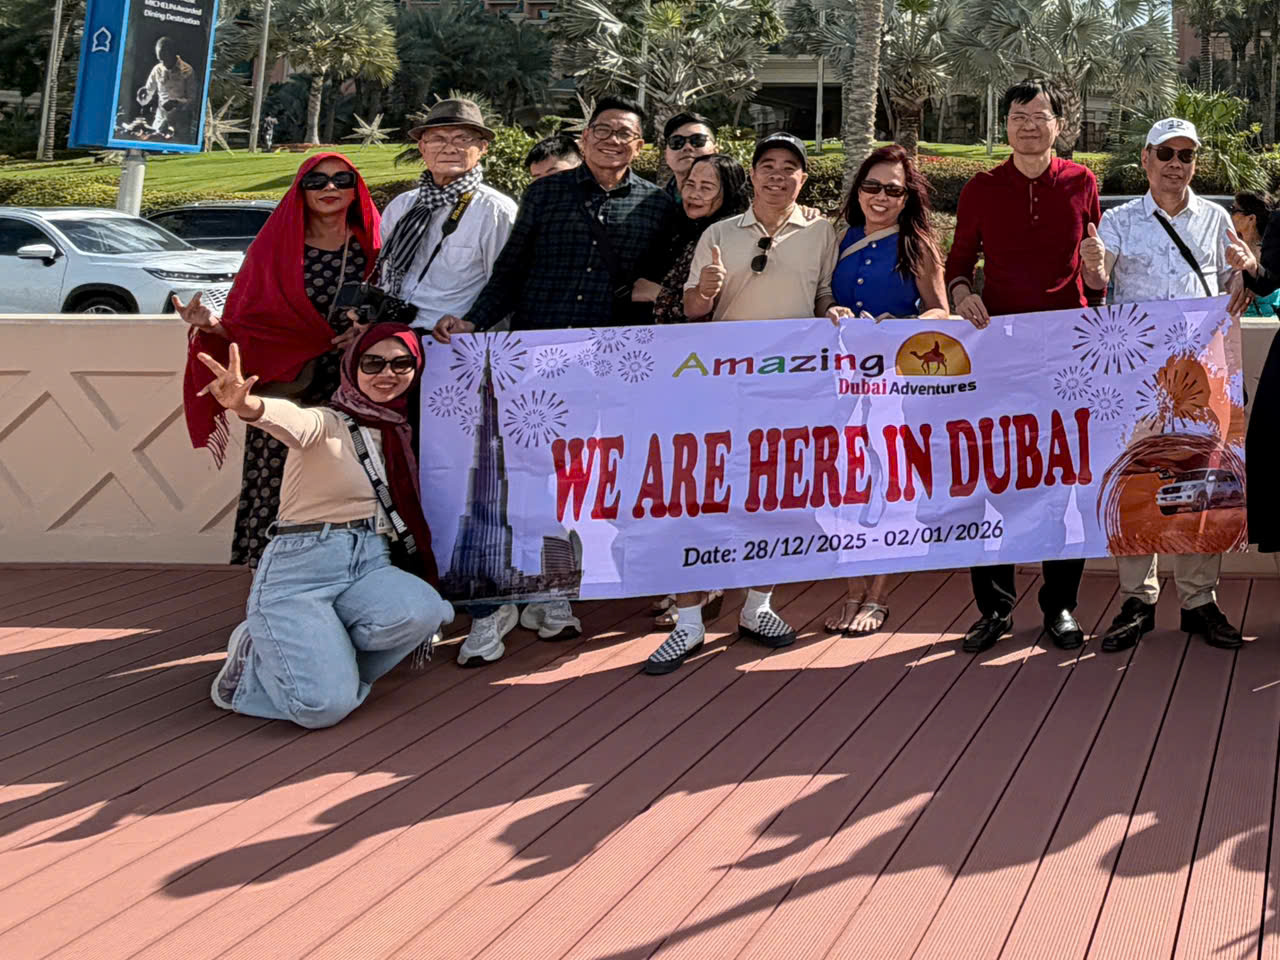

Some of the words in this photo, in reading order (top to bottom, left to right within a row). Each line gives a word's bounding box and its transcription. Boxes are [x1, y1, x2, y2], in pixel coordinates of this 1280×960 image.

[672, 348, 884, 378] Amazing
[838, 377, 887, 396] Dubai
[888, 379, 977, 396] Adventures
[551, 434, 624, 523] WE
[632, 429, 732, 519] ARE
[744, 423, 872, 512] HERE
[882, 423, 932, 502] IN
[946, 407, 1093, 497] DUBAI
[682, 546, 737, 568] Date:
[743, 532, 866, 561] 28/12/2025
[883, 519, 1004, 547] 02/01/2026
